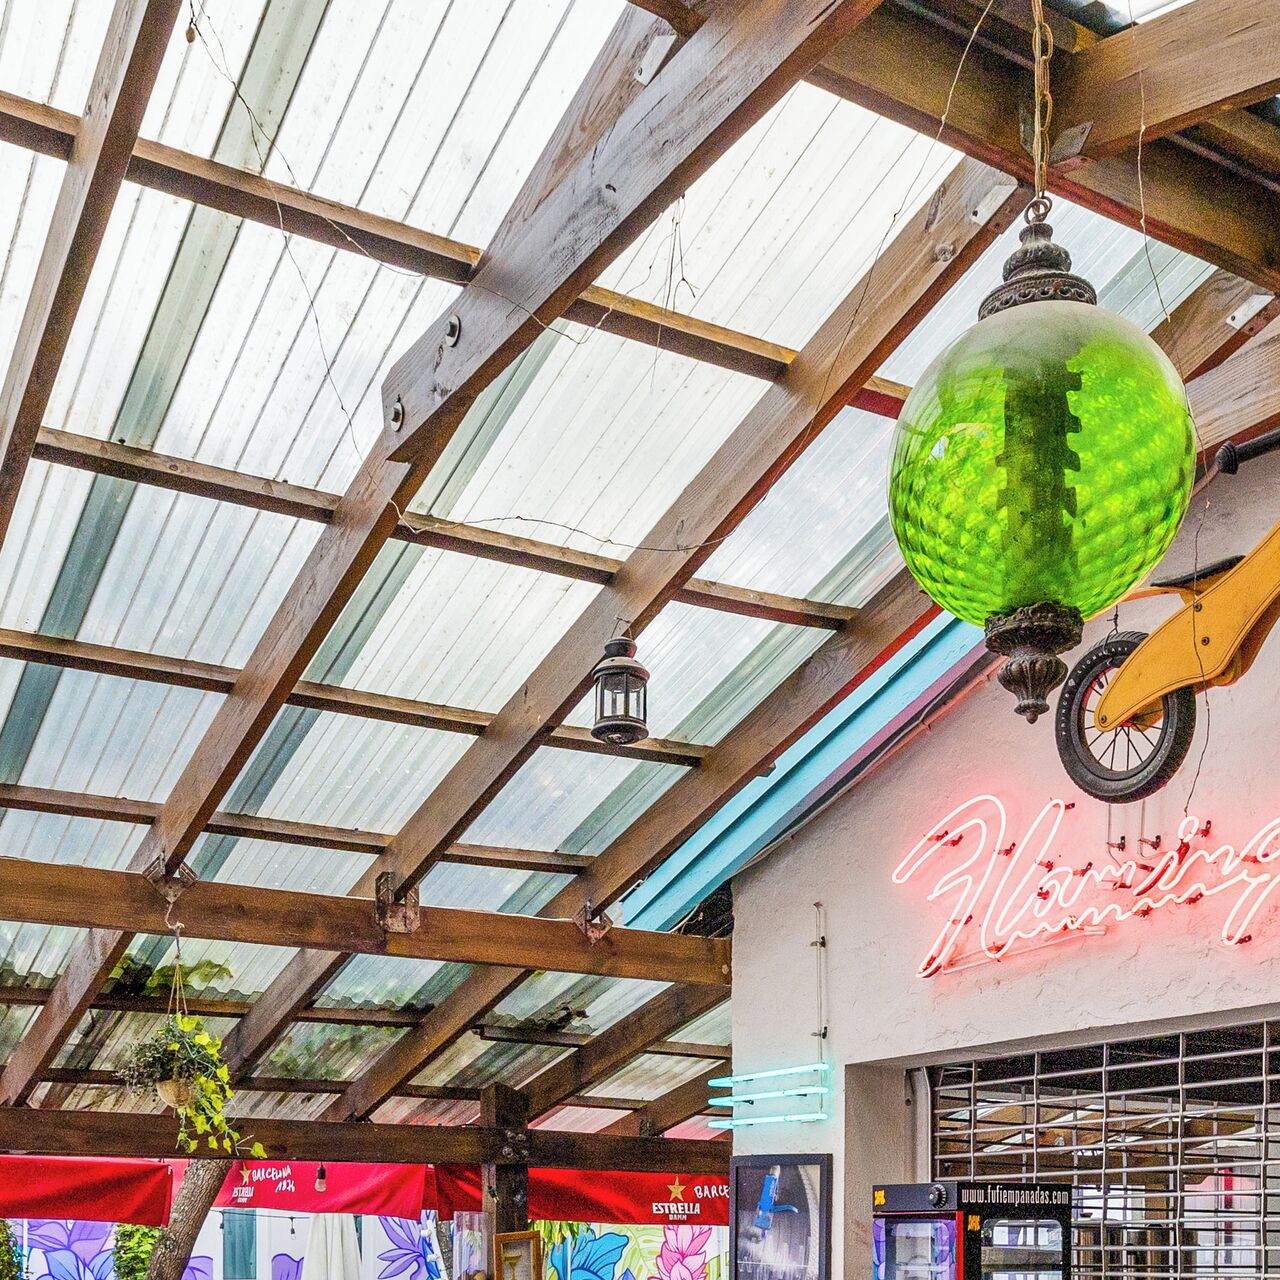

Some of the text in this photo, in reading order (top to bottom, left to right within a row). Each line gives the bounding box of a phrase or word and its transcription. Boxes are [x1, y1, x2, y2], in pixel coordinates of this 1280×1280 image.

[1078, 647, 1128, 674] LIONHART
[961, 1185, 1069, 1207] www.fufiempanadas.com
[652, 1202, 701, 1215] ESTRELLA
